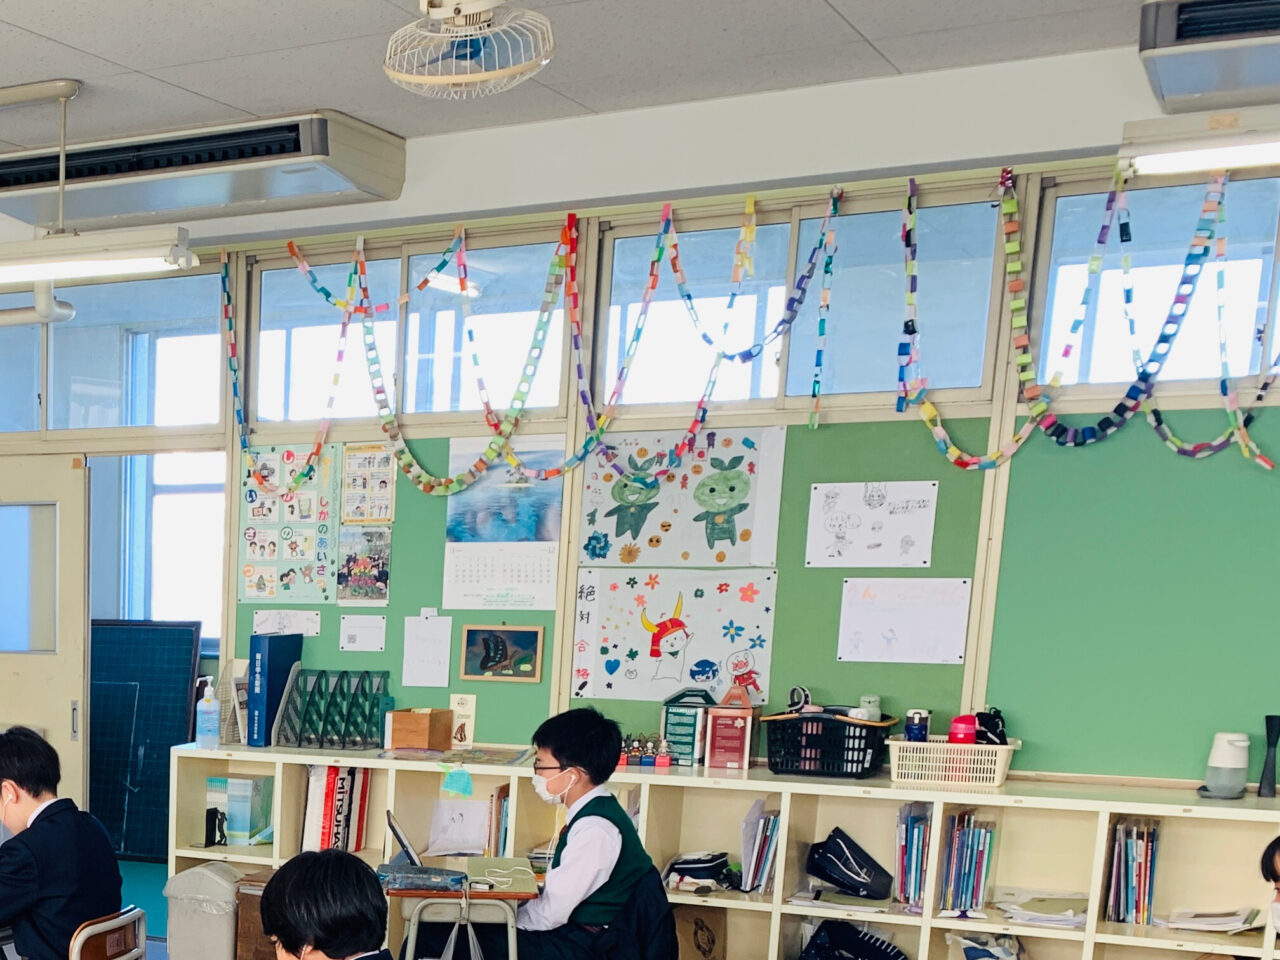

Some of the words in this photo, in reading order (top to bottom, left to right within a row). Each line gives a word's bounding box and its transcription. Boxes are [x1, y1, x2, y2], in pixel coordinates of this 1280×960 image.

[316, 496, 329, 589] しかのあいさつ
